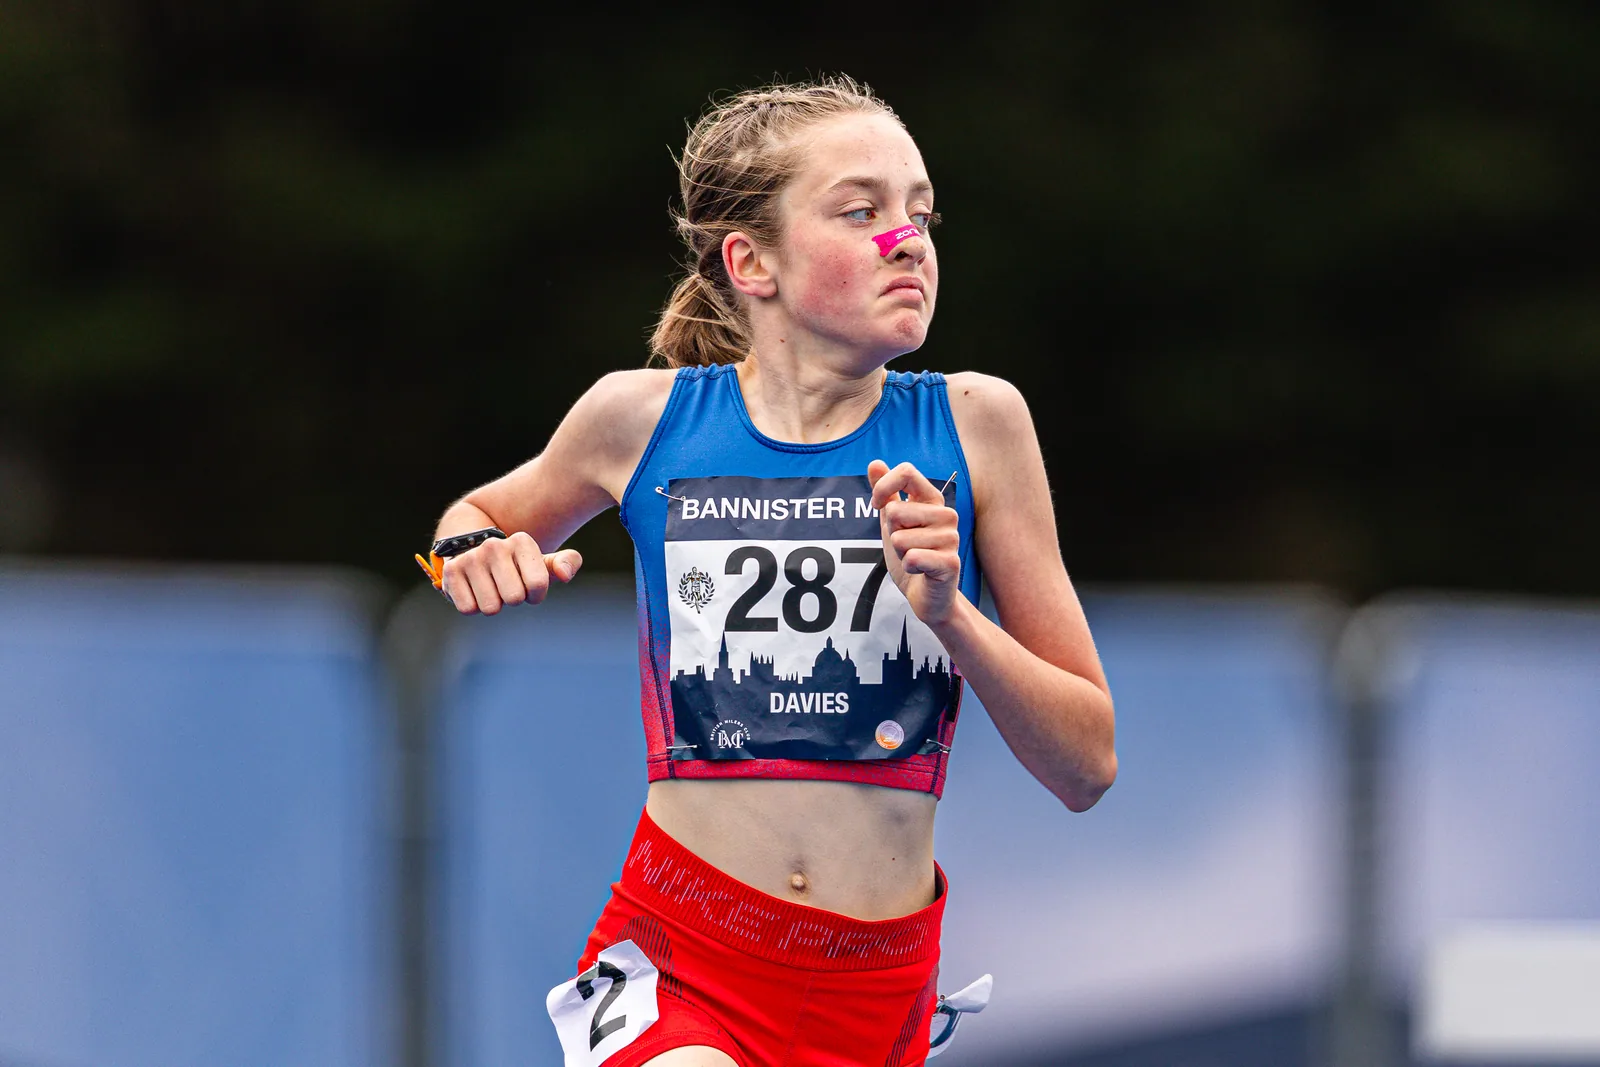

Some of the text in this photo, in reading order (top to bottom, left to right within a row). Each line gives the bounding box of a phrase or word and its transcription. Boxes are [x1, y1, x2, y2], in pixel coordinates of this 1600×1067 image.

[681, 497, 845, 520] BANNISTER
[724, 545, 888, 634] 287
[769, 692, 850, 714] DAVIES
[575, 960, 627, 1052] 2
